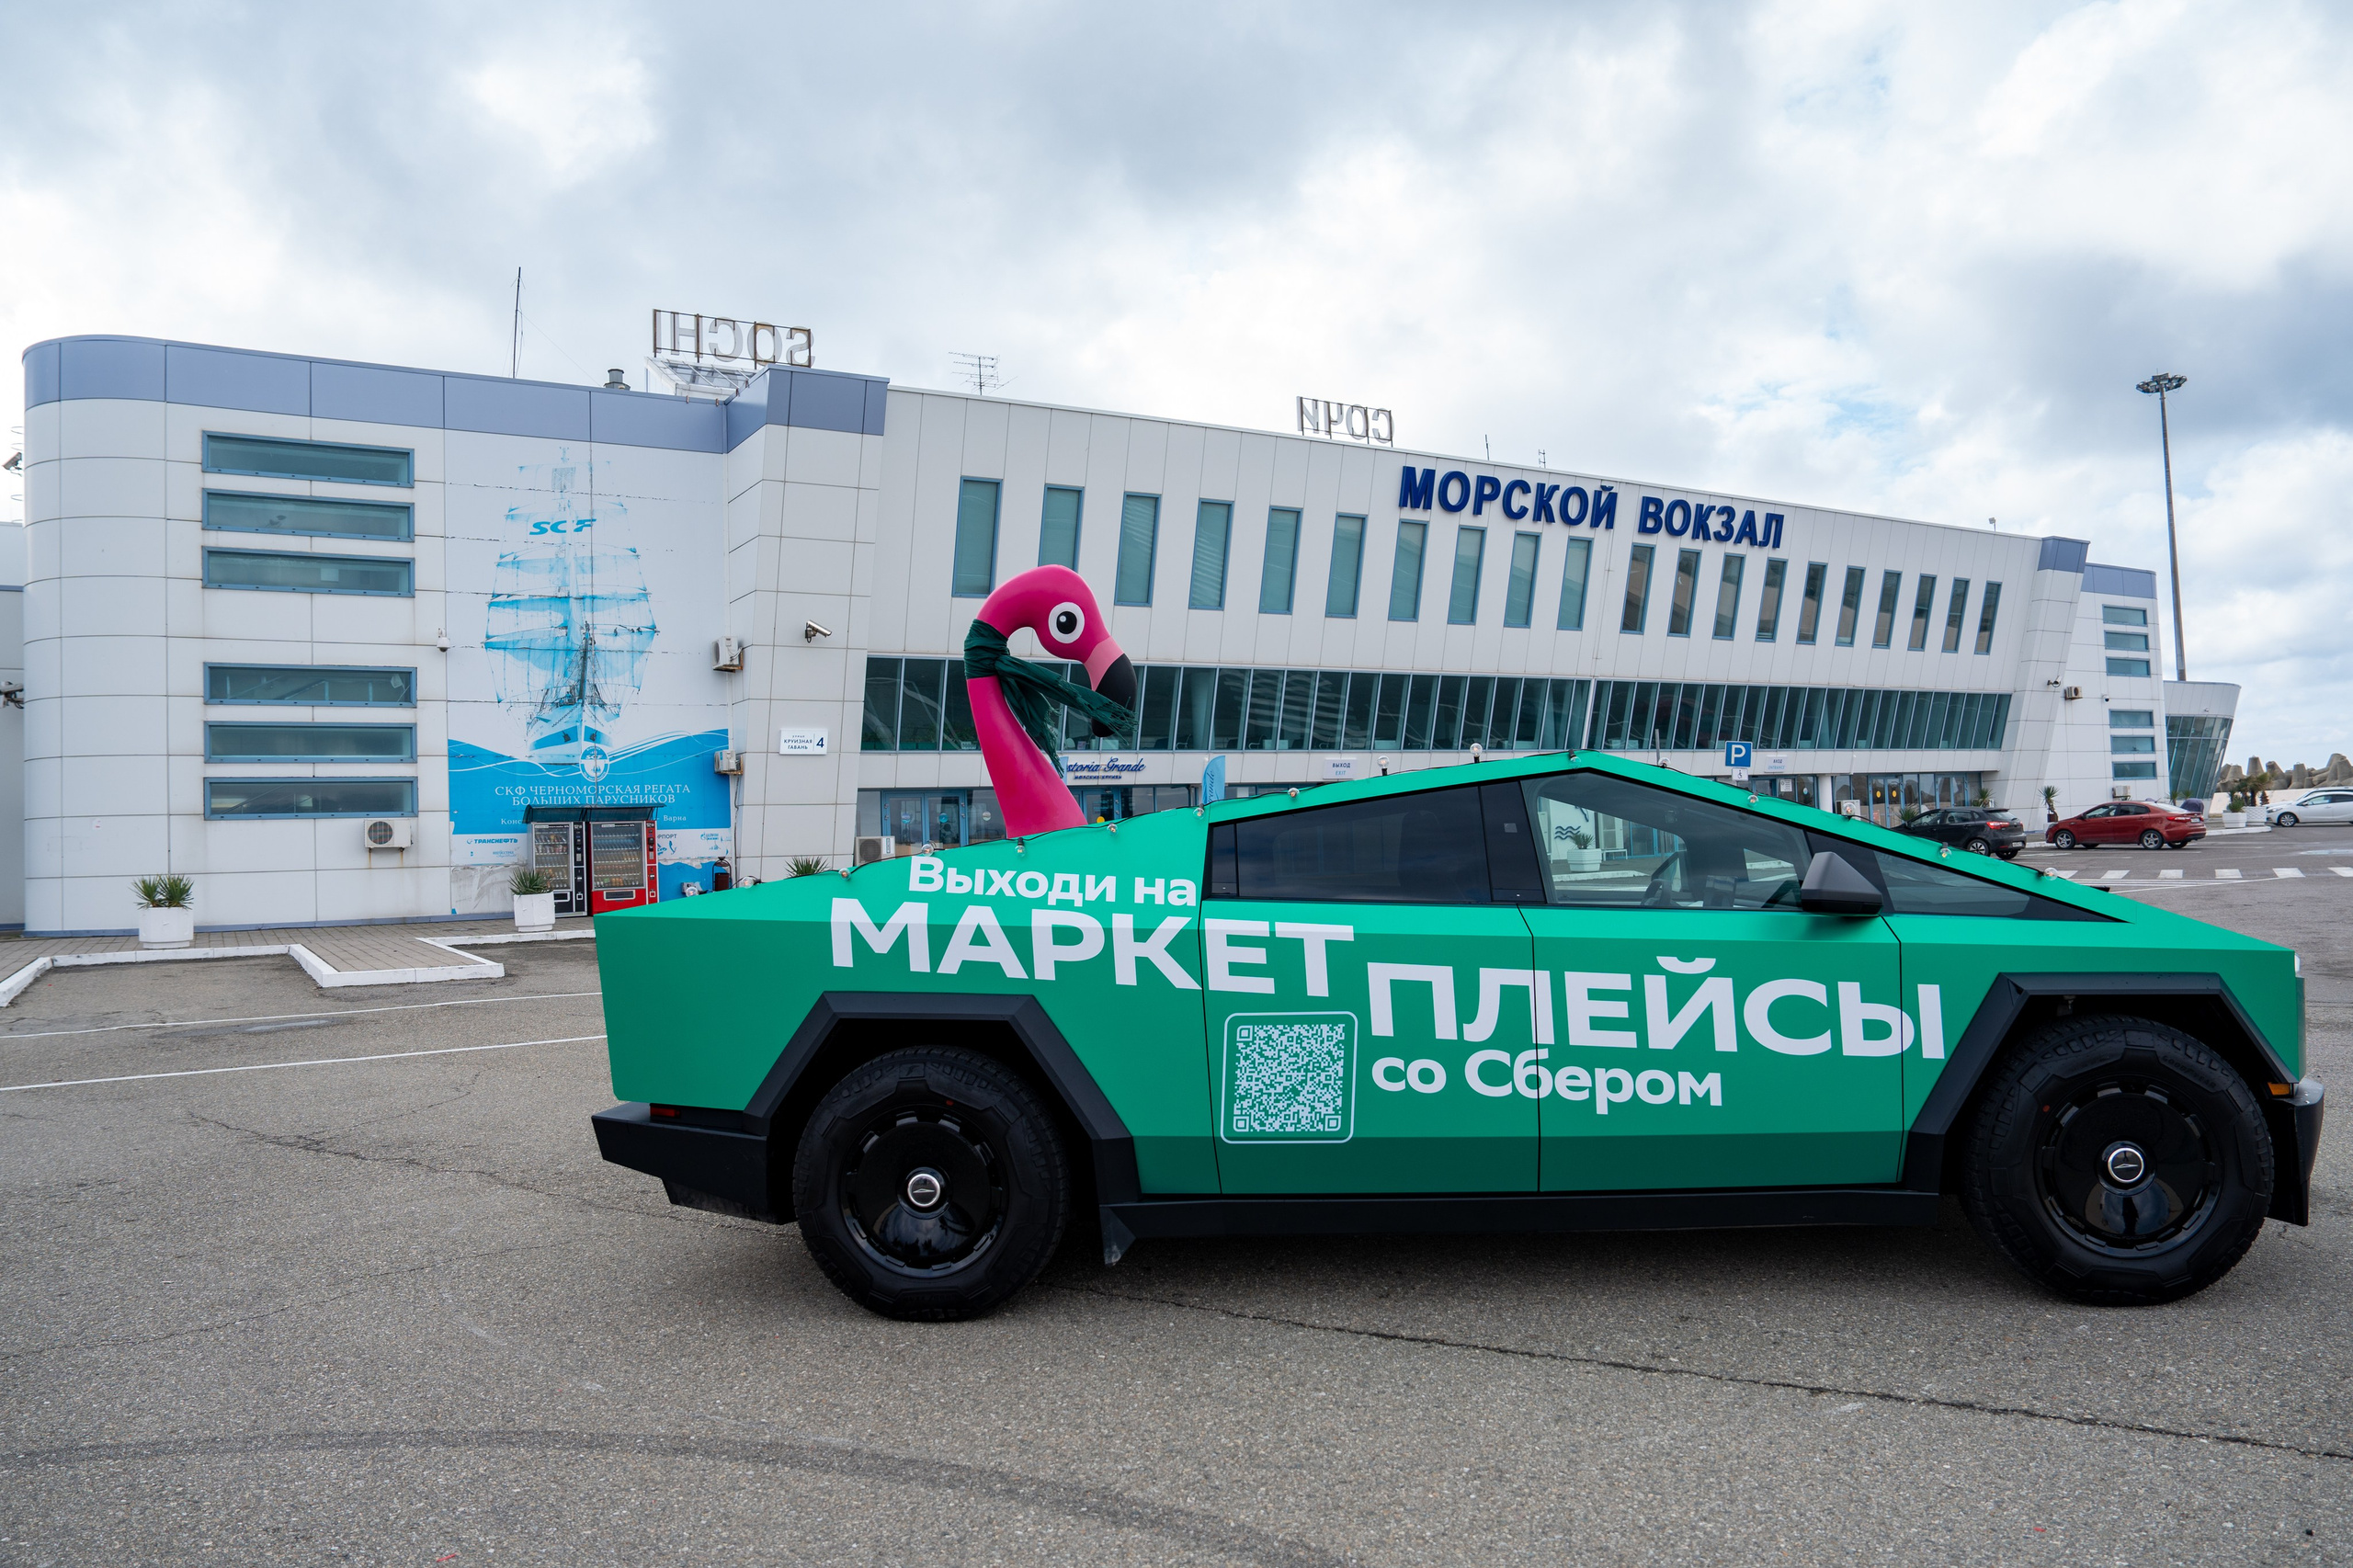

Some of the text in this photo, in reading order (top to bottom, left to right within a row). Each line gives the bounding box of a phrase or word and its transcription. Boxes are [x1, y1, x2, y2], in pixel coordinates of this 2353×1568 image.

[1398, 465, 1785, 550] МОРСКОЙ ВОКЗАЛ
[529, 518, 597, 536] SCF
[816, 737, 824, 748] 4
[1731, 744, 1745, 765] P
[1066, 756, 1147, 773] storia Grande
[494, 784, 691, 796] СКФ ЧЕРНОМОРСКАЯ РЕГАТА
[512, 794, 676, 806] БОЛЬШИХ ПАРУСНИКОВ
[663, 814, 687, 823] Варна
[907, 856, 1197, 907] Выходи на
[830, 897, 1355, 998] МАРКЕТ
[1367, 955, 1946, 1060] ПЛЕЙСЫ
[1371, 1048, 1722, 1115] со Сбером
